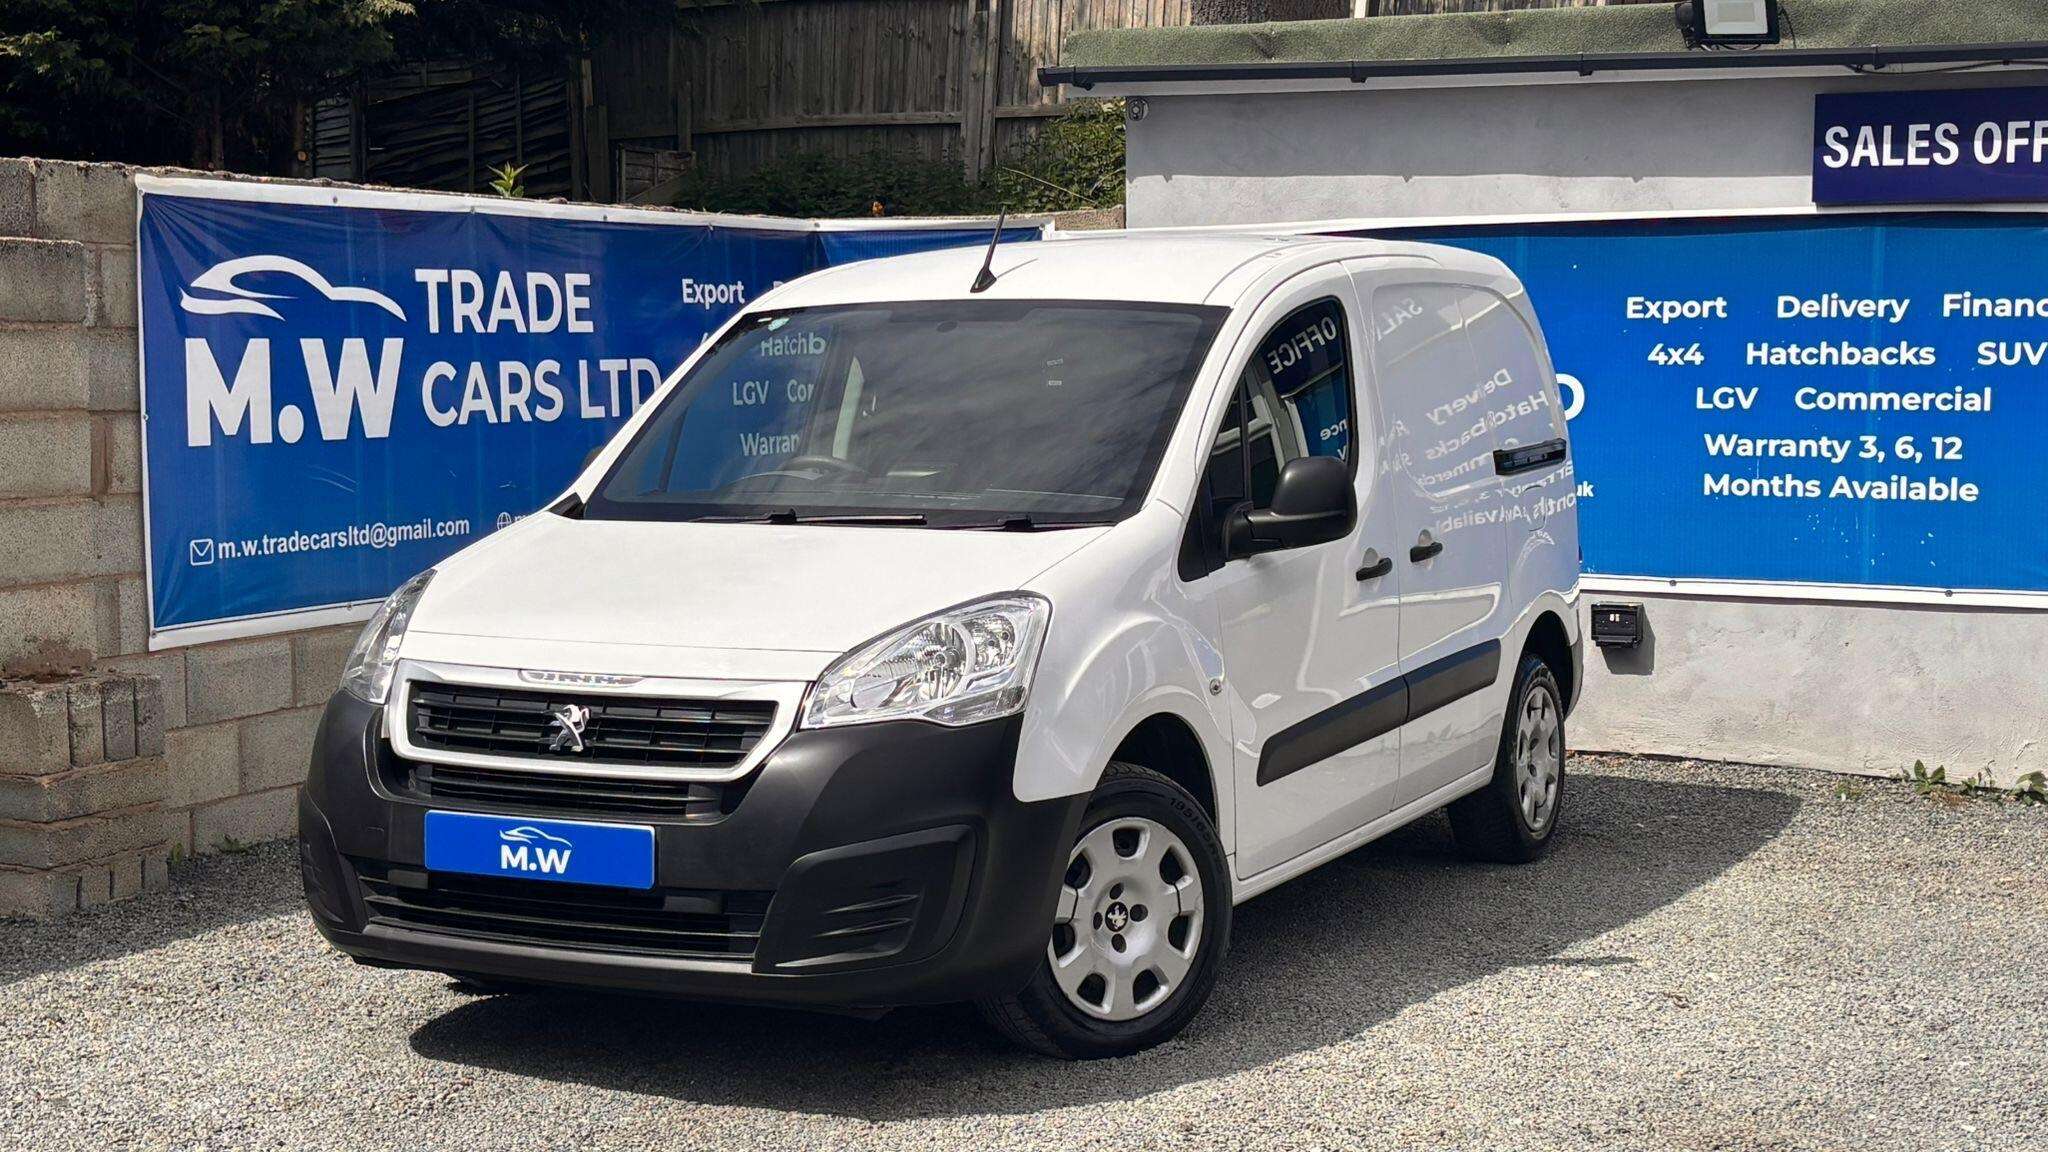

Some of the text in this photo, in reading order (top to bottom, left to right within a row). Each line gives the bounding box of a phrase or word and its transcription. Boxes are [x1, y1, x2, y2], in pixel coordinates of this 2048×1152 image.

[1822, 120, 2048, 169] SALES OFF
[415, 268, 594, 334] TRADE
[682, 278, 745, 310] Export
[1626, 291, 2048, 324] Export Delivery Financ
[761, 332, 826, 357] Hatchb
[1647, 342, 1705, 366] 4x4
[1746, 340, 1936, 367] Hatchbacks
[184, 337, 404, 447] M.W
[421, 357, 662, 426] CARS LTD
[732, 380, 769, 406] LGV
[1696, 386, 1992, 412] LGV Commercial
[740, 432, 800, 457] Warran
[1704, 433, 1963, 463] Warranty 3, 6, 12
[1703, 474, 1979, 503] Months Available
[218, 518, 470, 559] m.w.tradecarsltd@gmail.com
[500, 845, 572, 875] M.W
